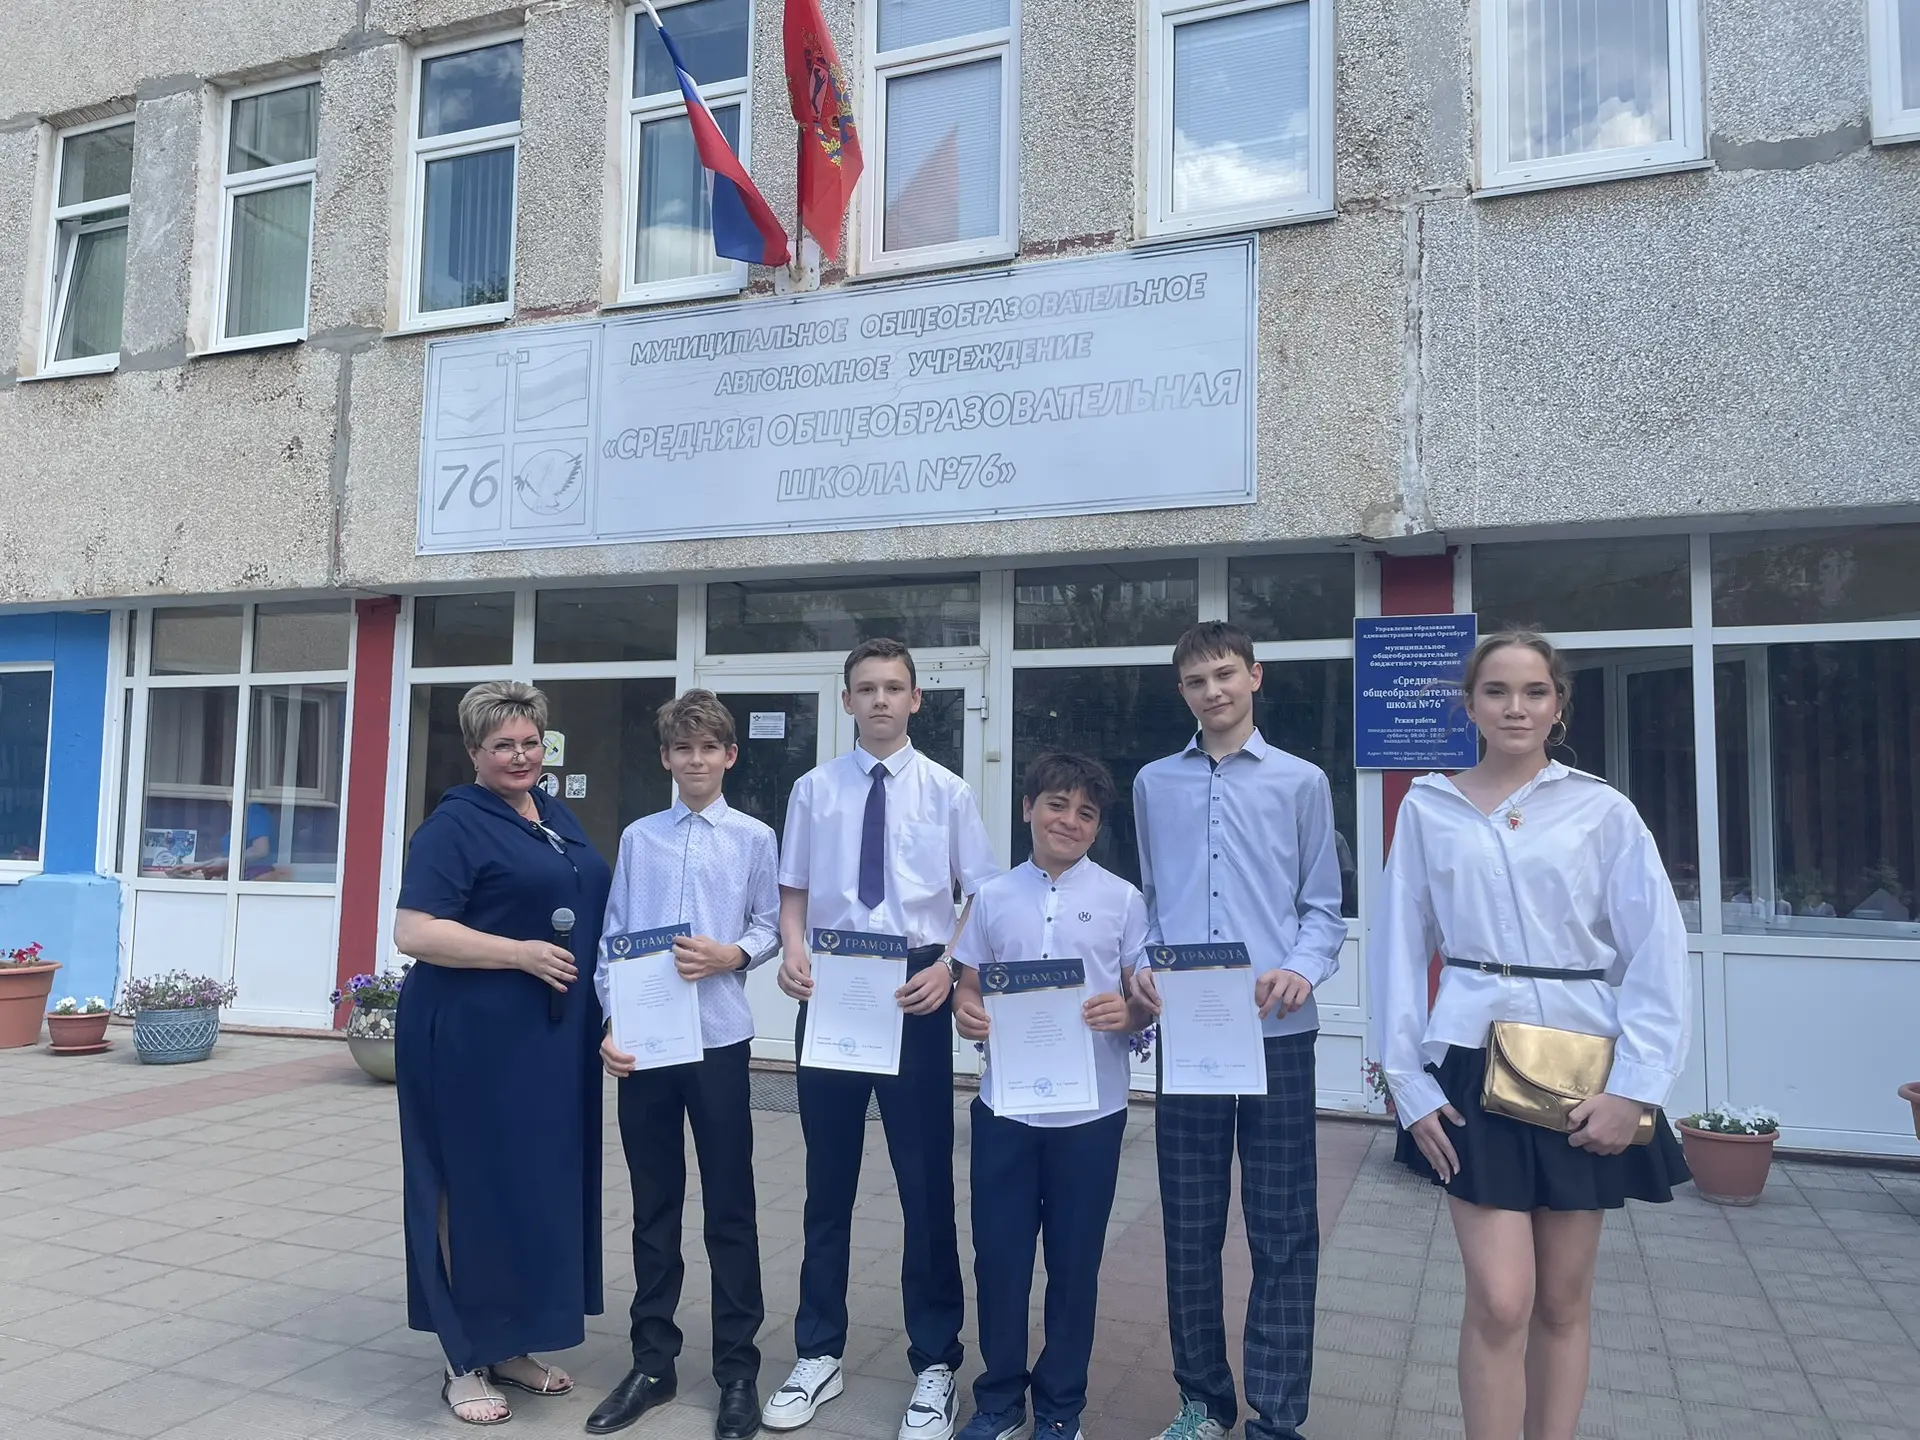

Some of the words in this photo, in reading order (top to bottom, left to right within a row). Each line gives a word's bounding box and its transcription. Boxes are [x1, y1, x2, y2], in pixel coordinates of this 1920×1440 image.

[630, 317, 849, 365] МУНИЦИПАЛЬНОЕ
[861, 272, 1207, 338] ОБЩЕОБРАЗОВАТЕЛЬНОЕ
[714, 355, 891, 396] АВТОНОМНОЕ
[909, 332, 1093, 376] УЧРЕЖДЕНИЕ
[603, 416, 762, 461] «СРЕДНЯЯ
[767, 369, 1241, 446] ОБЩЕОБРАЗОВАТЕЛЬНАЯ
[777, 461, 909, 501] ШКОЛА
[916, 453, 1016, 492] №76»
[438, 459, 500, 511] 76
[1375, 625, 1412, 633] Управление
[1413, 623, 1456, 632] образования
[1373, 650, 1459, 660] общеобразовательное
[1384, 643, 1446, 652] муниципальное
[1370, 659, 1412, 668] бюджетное
[1413, 658, 1462, 667] учреждение
[1386, 699, 1417, 709] школа
[1415, 716, 1437, 725] работы
[845, 937, 903, 953] ГРАМОТА
[1181, 949, 1245, 963] ГРАМОТА
[1014, 969, 1079, 986] ГРАМОТА
